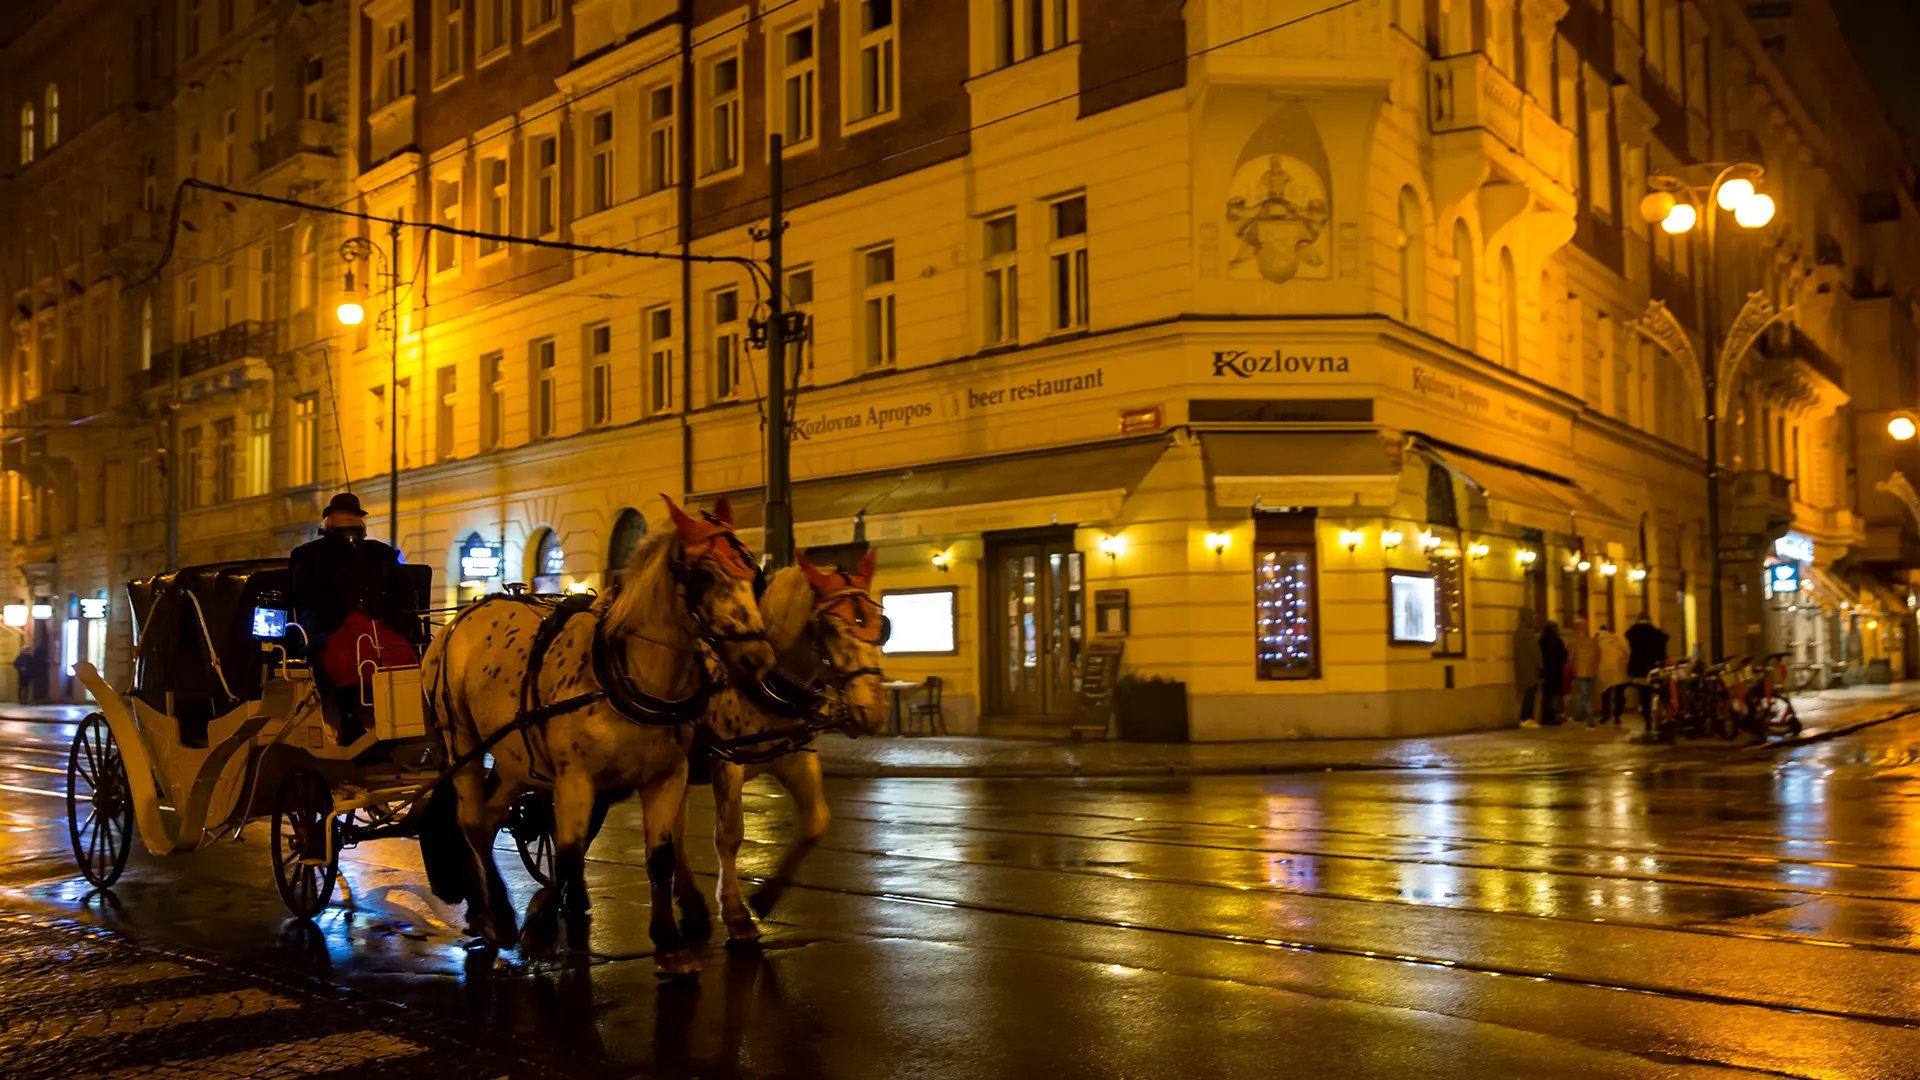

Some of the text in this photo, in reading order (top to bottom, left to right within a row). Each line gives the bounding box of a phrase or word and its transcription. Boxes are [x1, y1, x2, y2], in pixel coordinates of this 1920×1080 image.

[1212, 350, 1350, 378] Kozlovna
[790, 367, 1105, 441] Kozlovna Apropos beer restaurant
